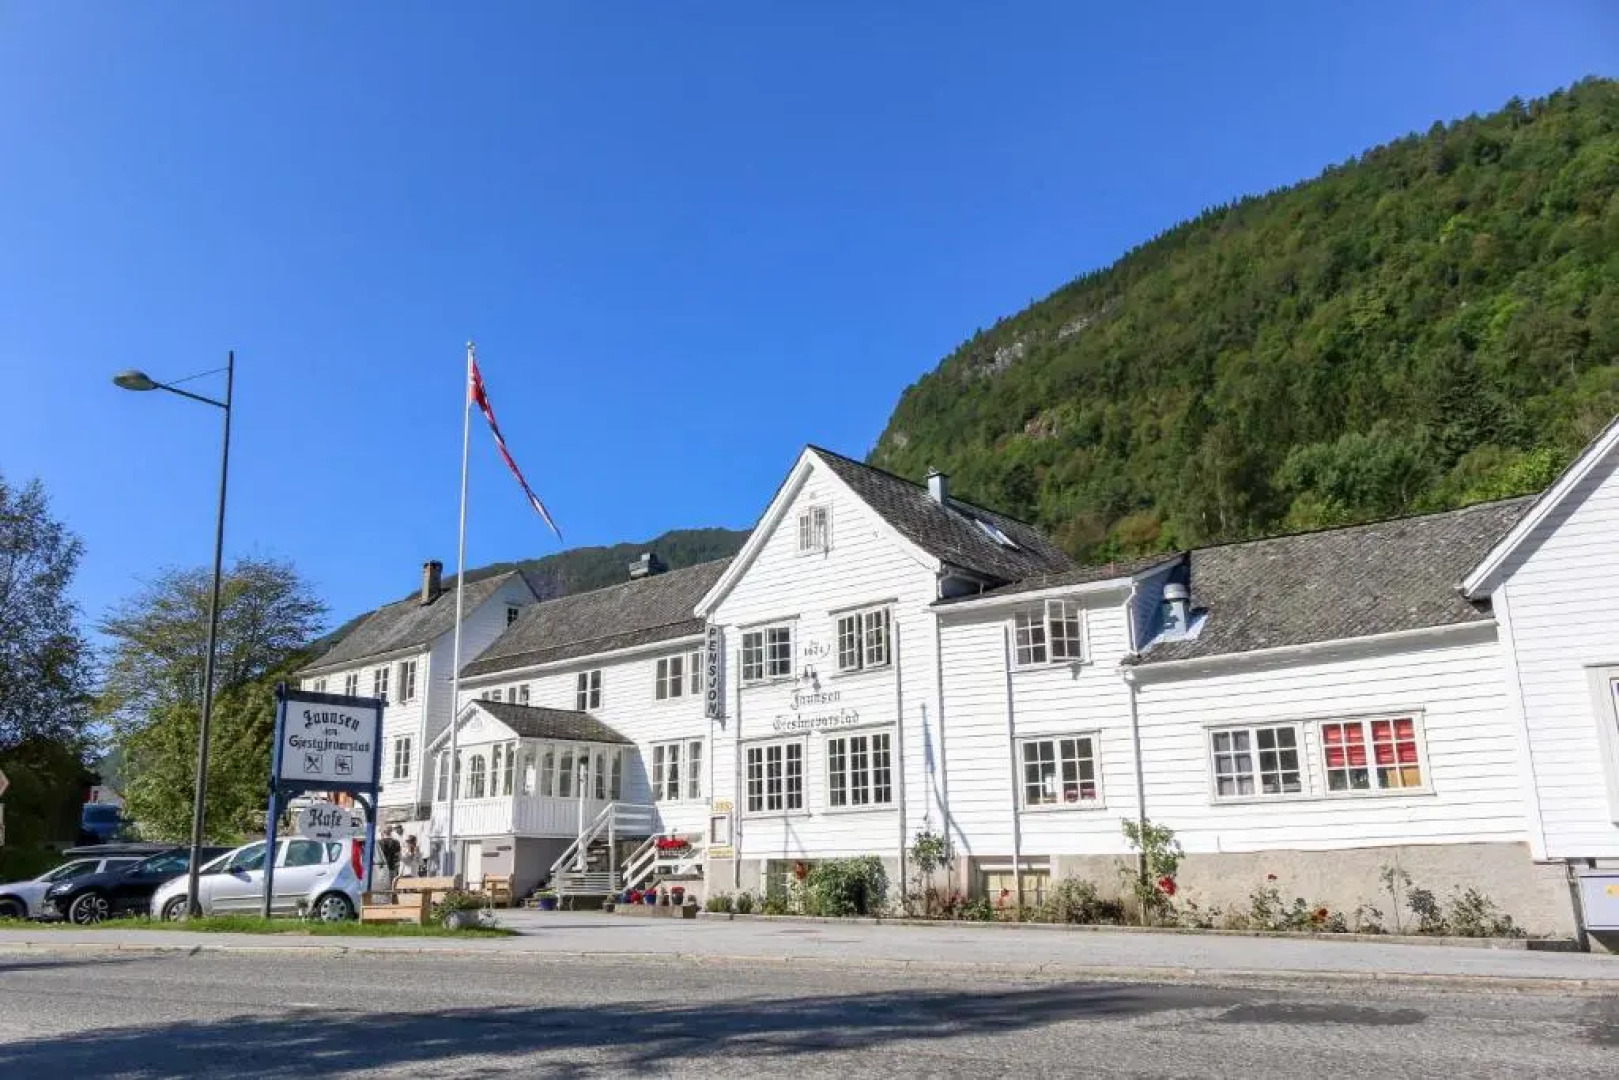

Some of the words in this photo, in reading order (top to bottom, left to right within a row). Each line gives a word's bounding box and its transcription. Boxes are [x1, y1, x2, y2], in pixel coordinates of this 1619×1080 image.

[707, 627, 717, 714] PENSJON
[303, 709, 360, 732] Jaunsen
[308, 808, 342, 829] Kafe
